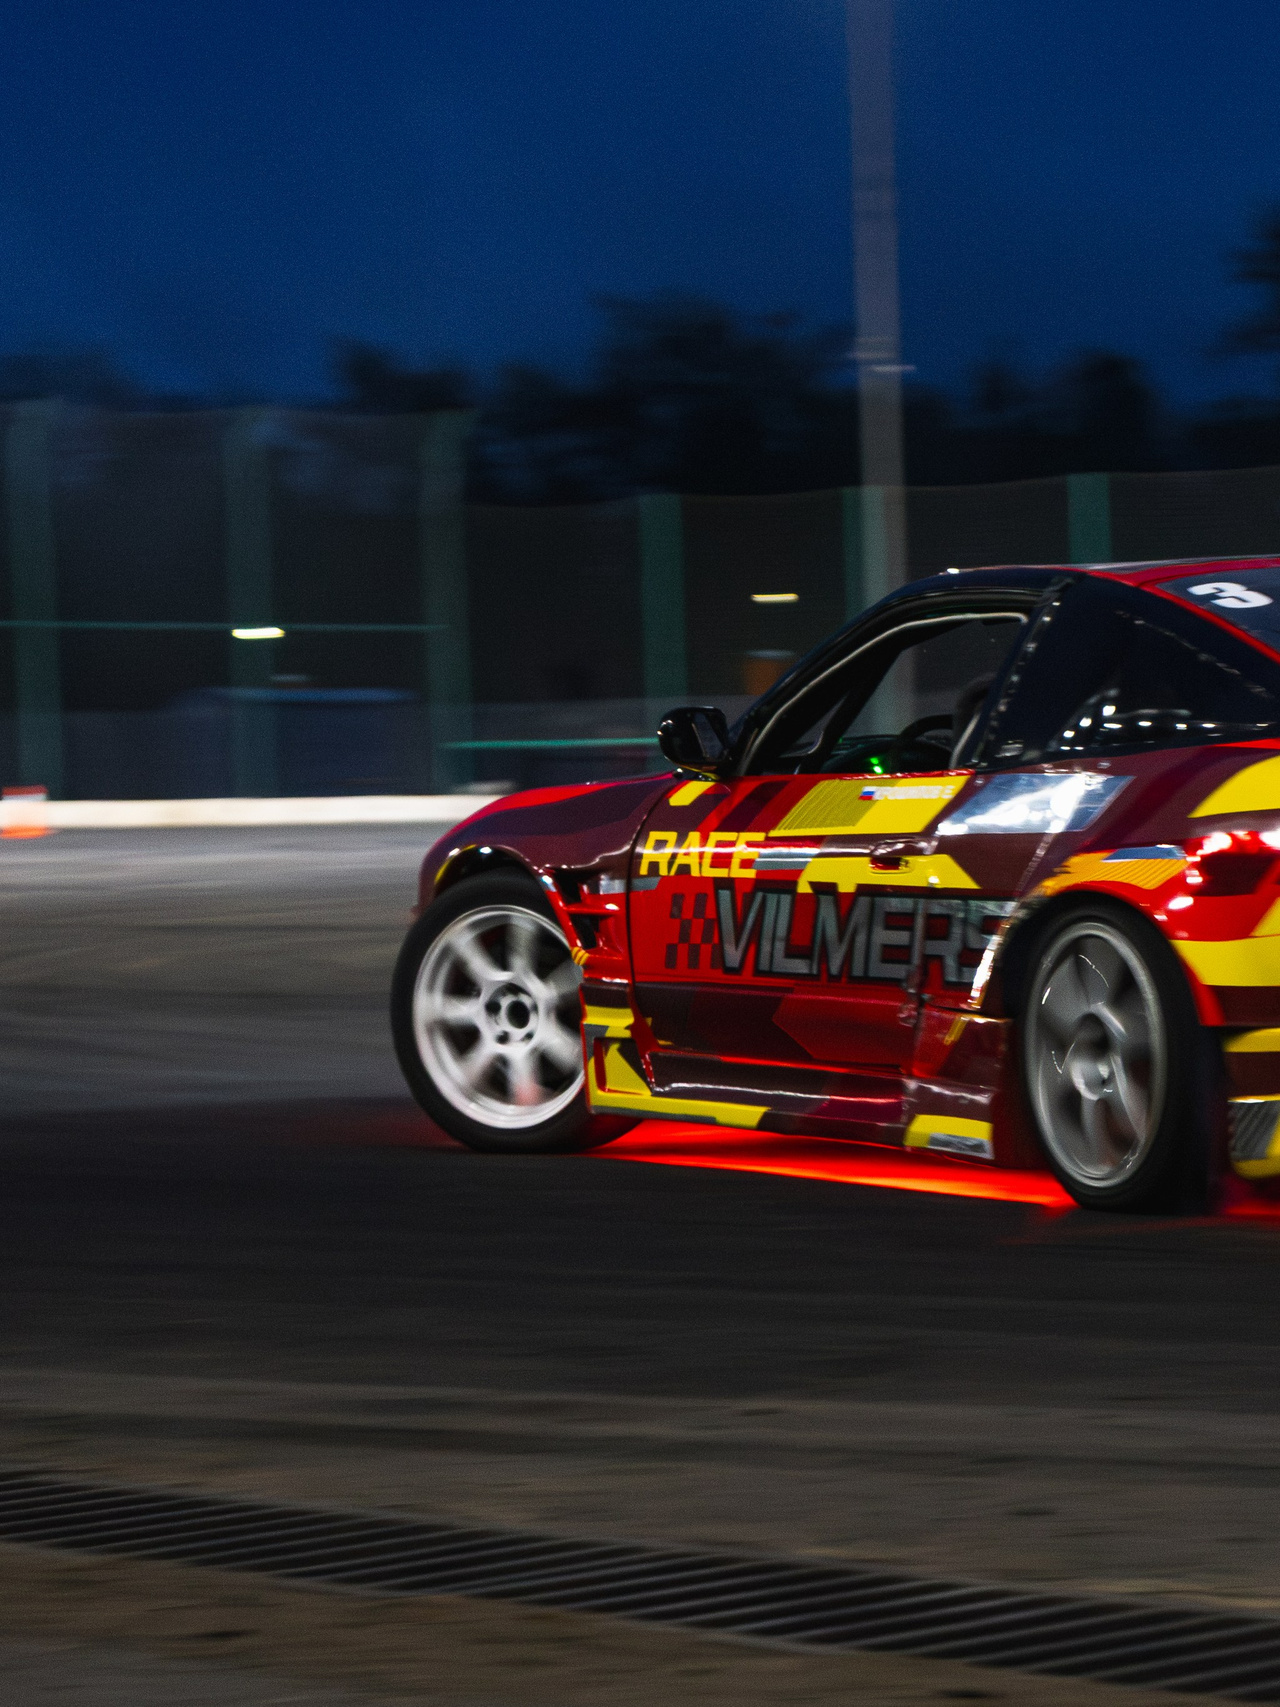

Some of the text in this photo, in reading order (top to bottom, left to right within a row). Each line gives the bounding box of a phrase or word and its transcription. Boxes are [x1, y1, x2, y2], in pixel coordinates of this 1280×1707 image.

[1187, 582, 1274, 608] 3
[639, 831, 766, 878] RACE
[714, 886, 1018, 983] VILMERS
